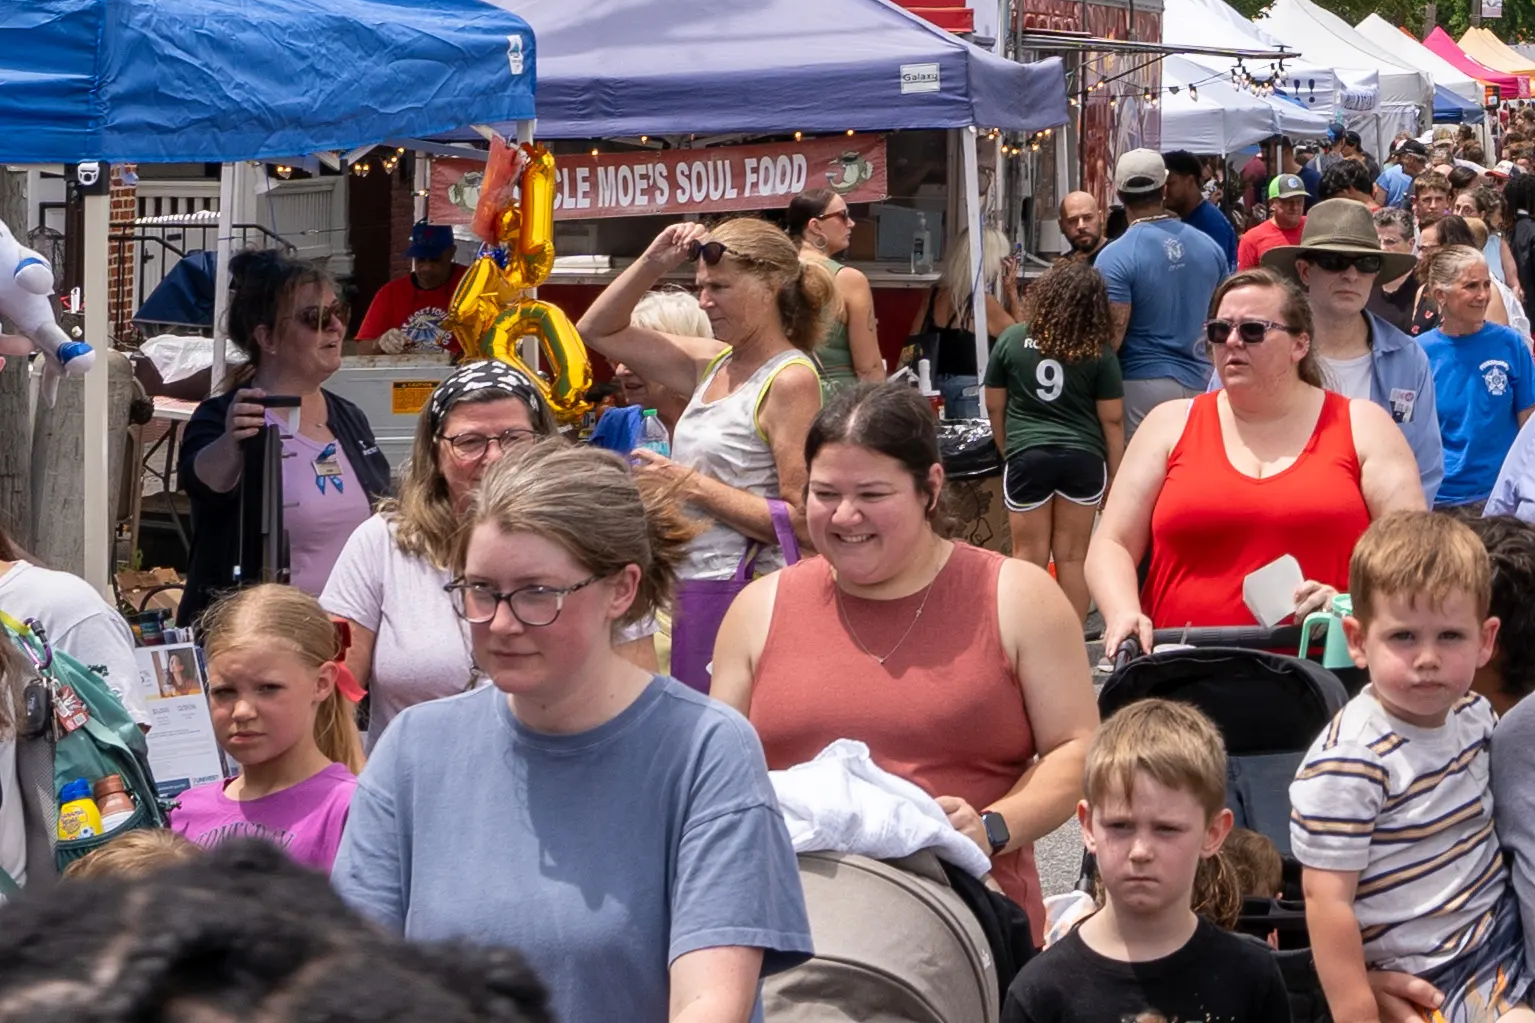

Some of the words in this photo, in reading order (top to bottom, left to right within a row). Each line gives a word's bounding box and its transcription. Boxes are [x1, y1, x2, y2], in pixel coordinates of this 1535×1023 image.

[902, 72, 939, 84] Galaxy
[598, 162, 669, 208] MOE'S
[675, 159, 738, 205] SOUL
[744, 153, 807, 198] FOOD
[1036, 358, 1064, 402] 9
